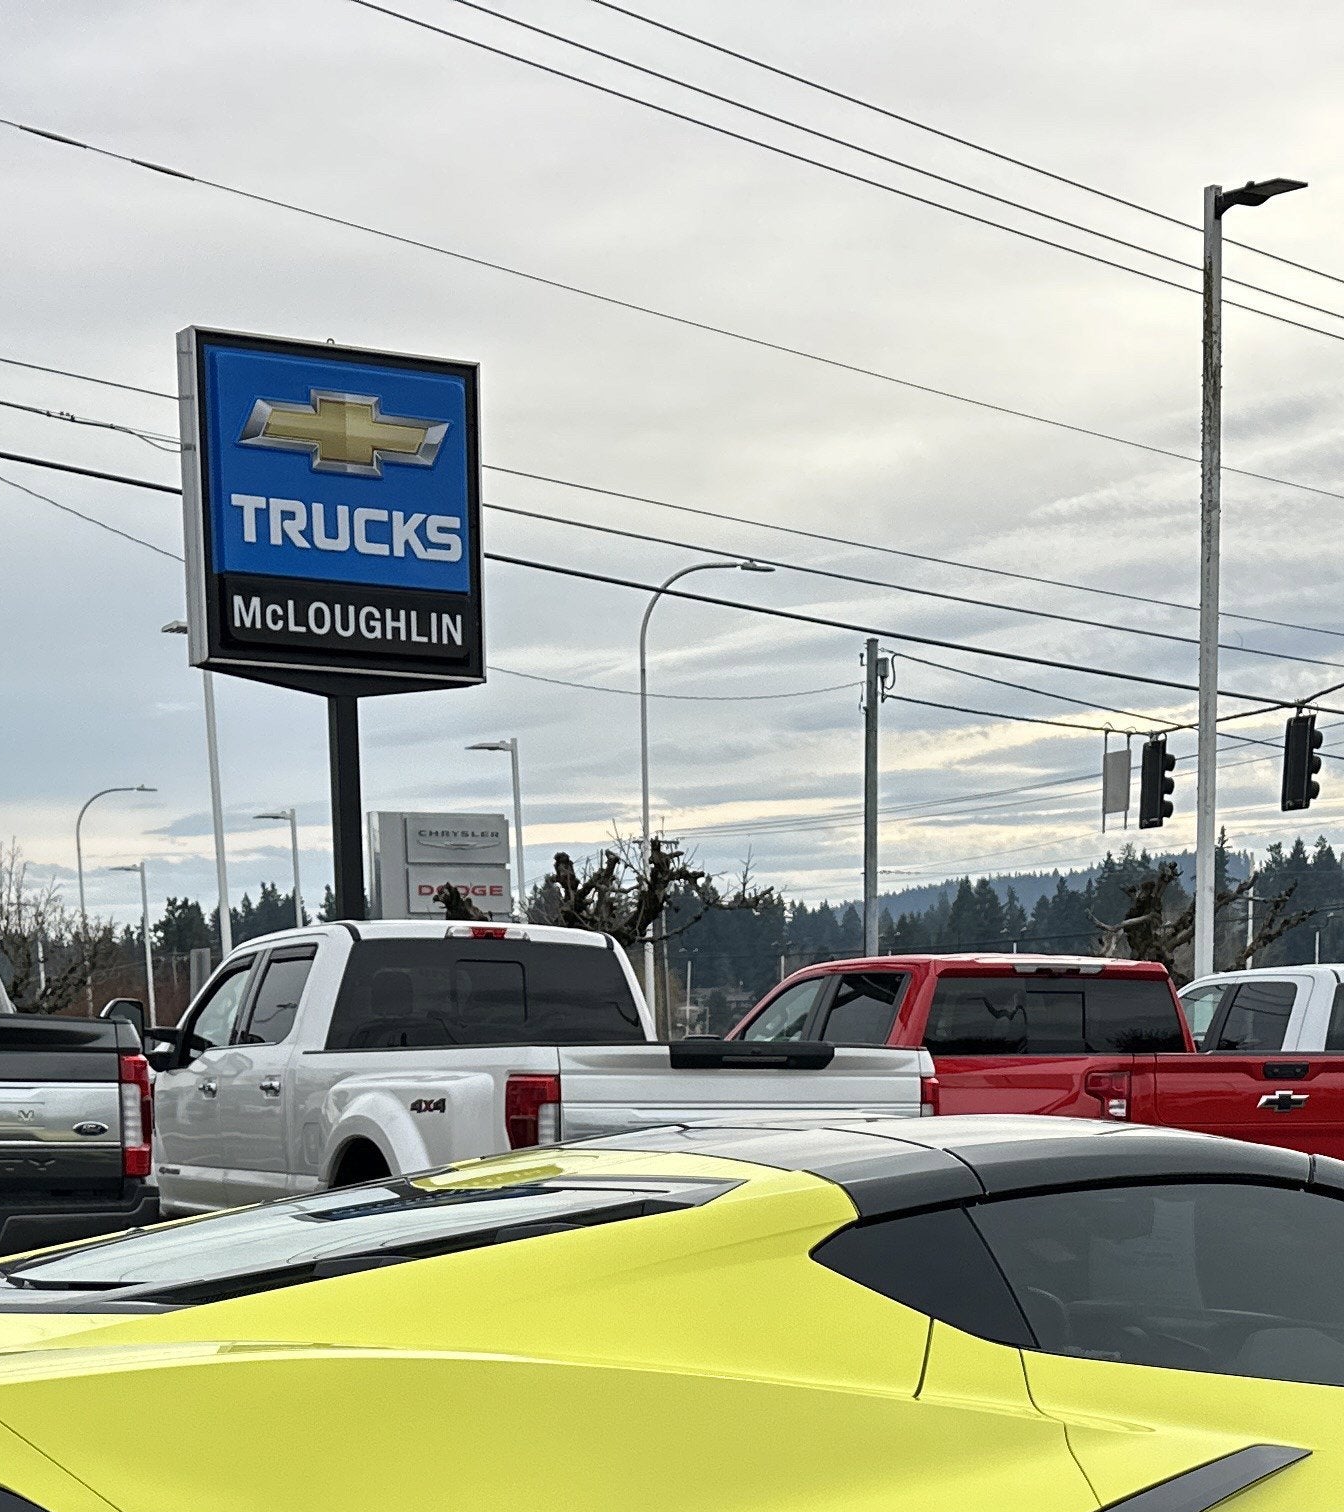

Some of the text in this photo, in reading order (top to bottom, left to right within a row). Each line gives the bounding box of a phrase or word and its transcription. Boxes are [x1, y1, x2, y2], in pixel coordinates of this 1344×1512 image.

[230, 493, 462, 562] TRUCKS
[232, 595, 463, 646] McLOUGHLIN
[418, 829, 499, 837] CHRYSLER
